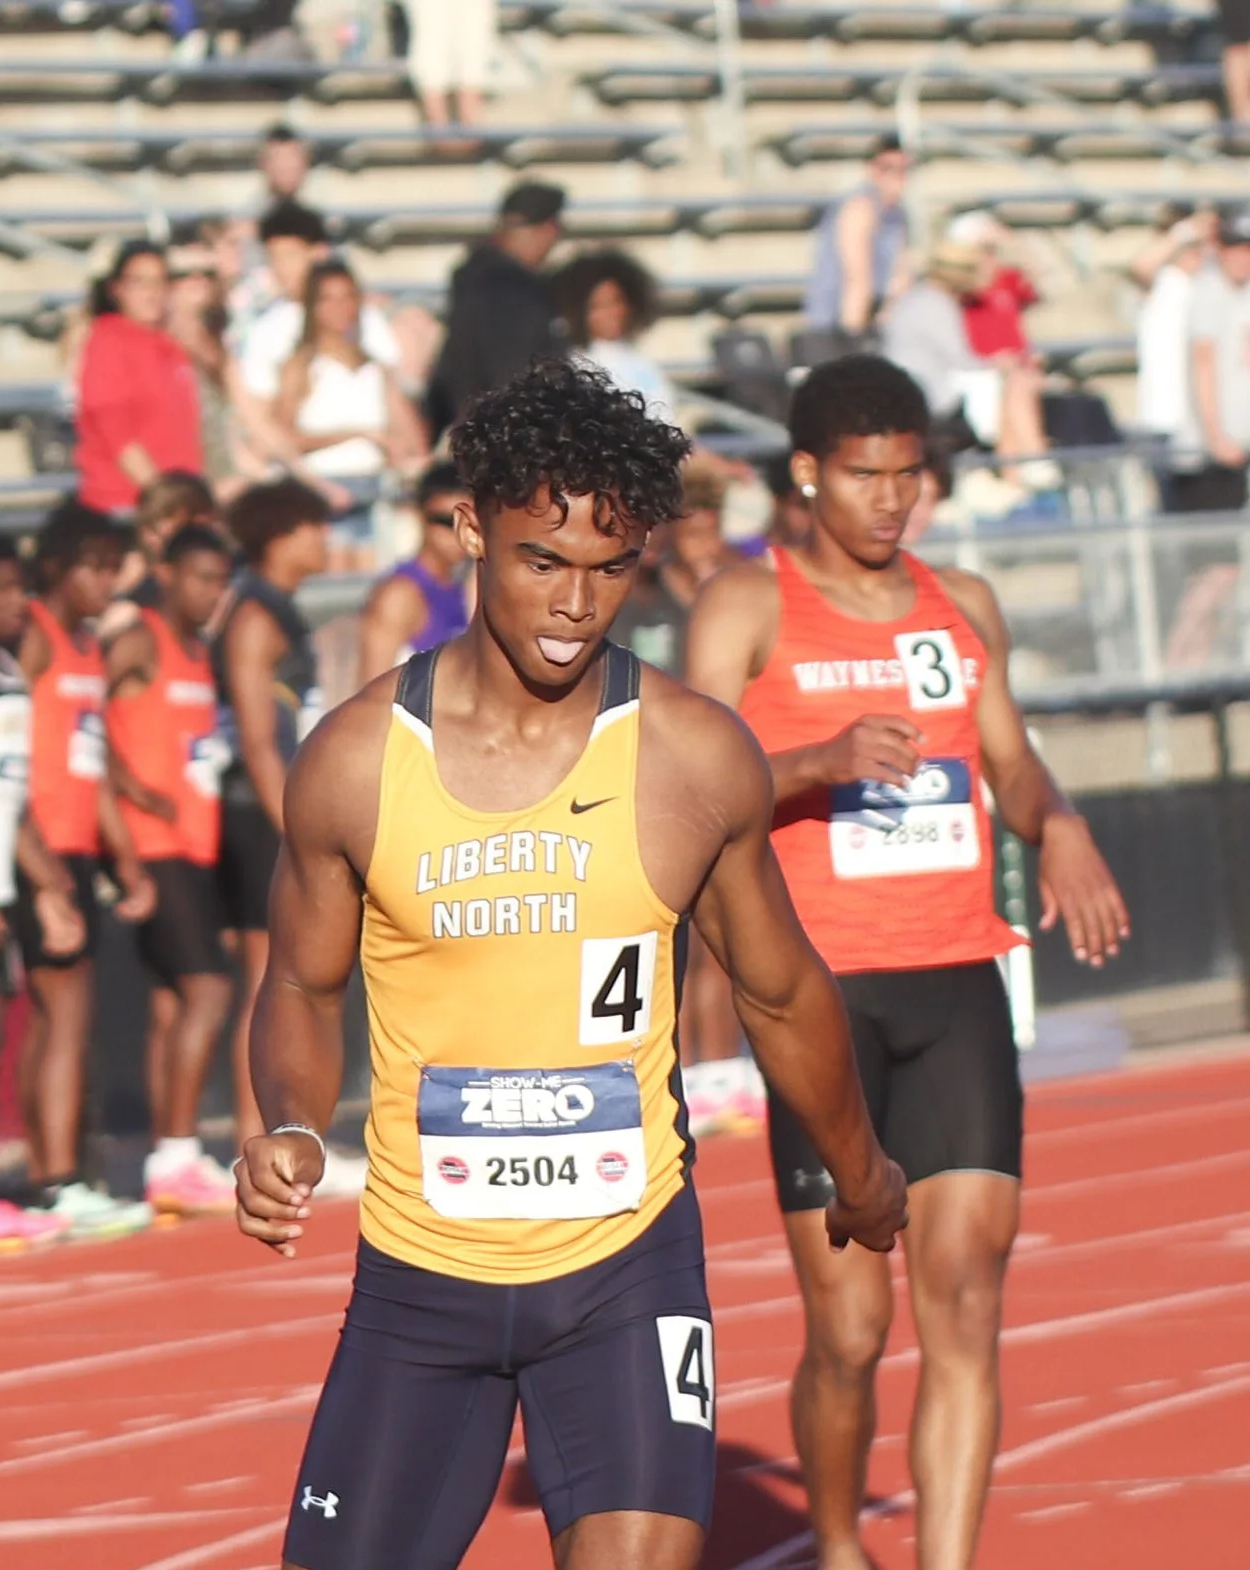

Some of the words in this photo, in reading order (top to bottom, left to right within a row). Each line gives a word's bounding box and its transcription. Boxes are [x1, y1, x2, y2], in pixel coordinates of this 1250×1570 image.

[912, 639, 952, 699] 3
[416, 830, 593, 895] LIBERTY
[432, 892, 578, 939] NORTH
[591, 943, 643, 1033] 4
[461, 1084, 595, 1124] ZERO
[490, 1075, 563, 1089] SHOW-ME
[486, 1155, 579, 1187] 2504
[676, 1326, 710, 1420] 4
